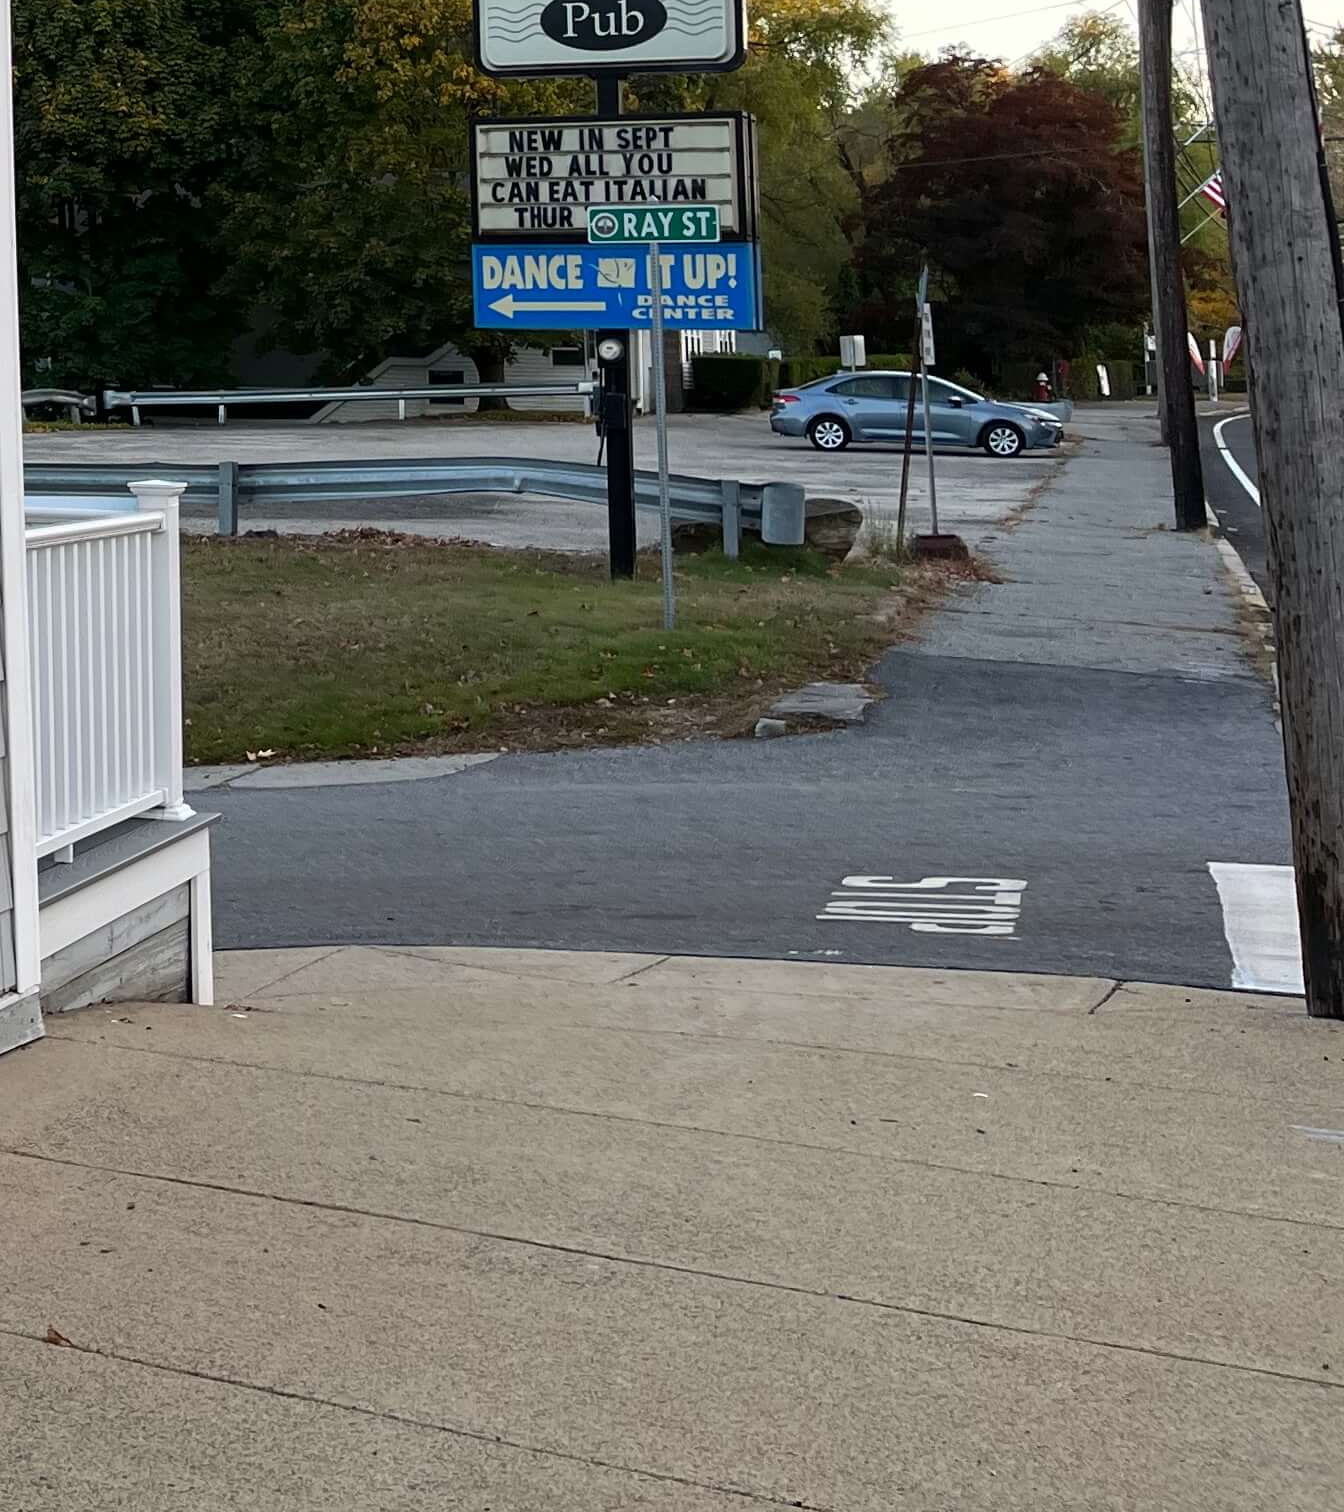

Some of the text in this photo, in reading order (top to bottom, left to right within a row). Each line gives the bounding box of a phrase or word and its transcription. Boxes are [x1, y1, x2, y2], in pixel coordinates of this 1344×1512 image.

[562, 0, 645, 38] Pub
[509, 127, 674, 153] NEW IN SEPT
[505, 153, 673, 178] WED ALL YOU
[491, 178, 707, 203] CAN EAT ITALIAN
[514, 206, 573, 229] THUR
[623, 211, 710, 237] RAY ST
[481, 255, 584, 290] DANCE
[682, 253, 737, 289] UP!
[631, 307, 735, 320] CNTER
